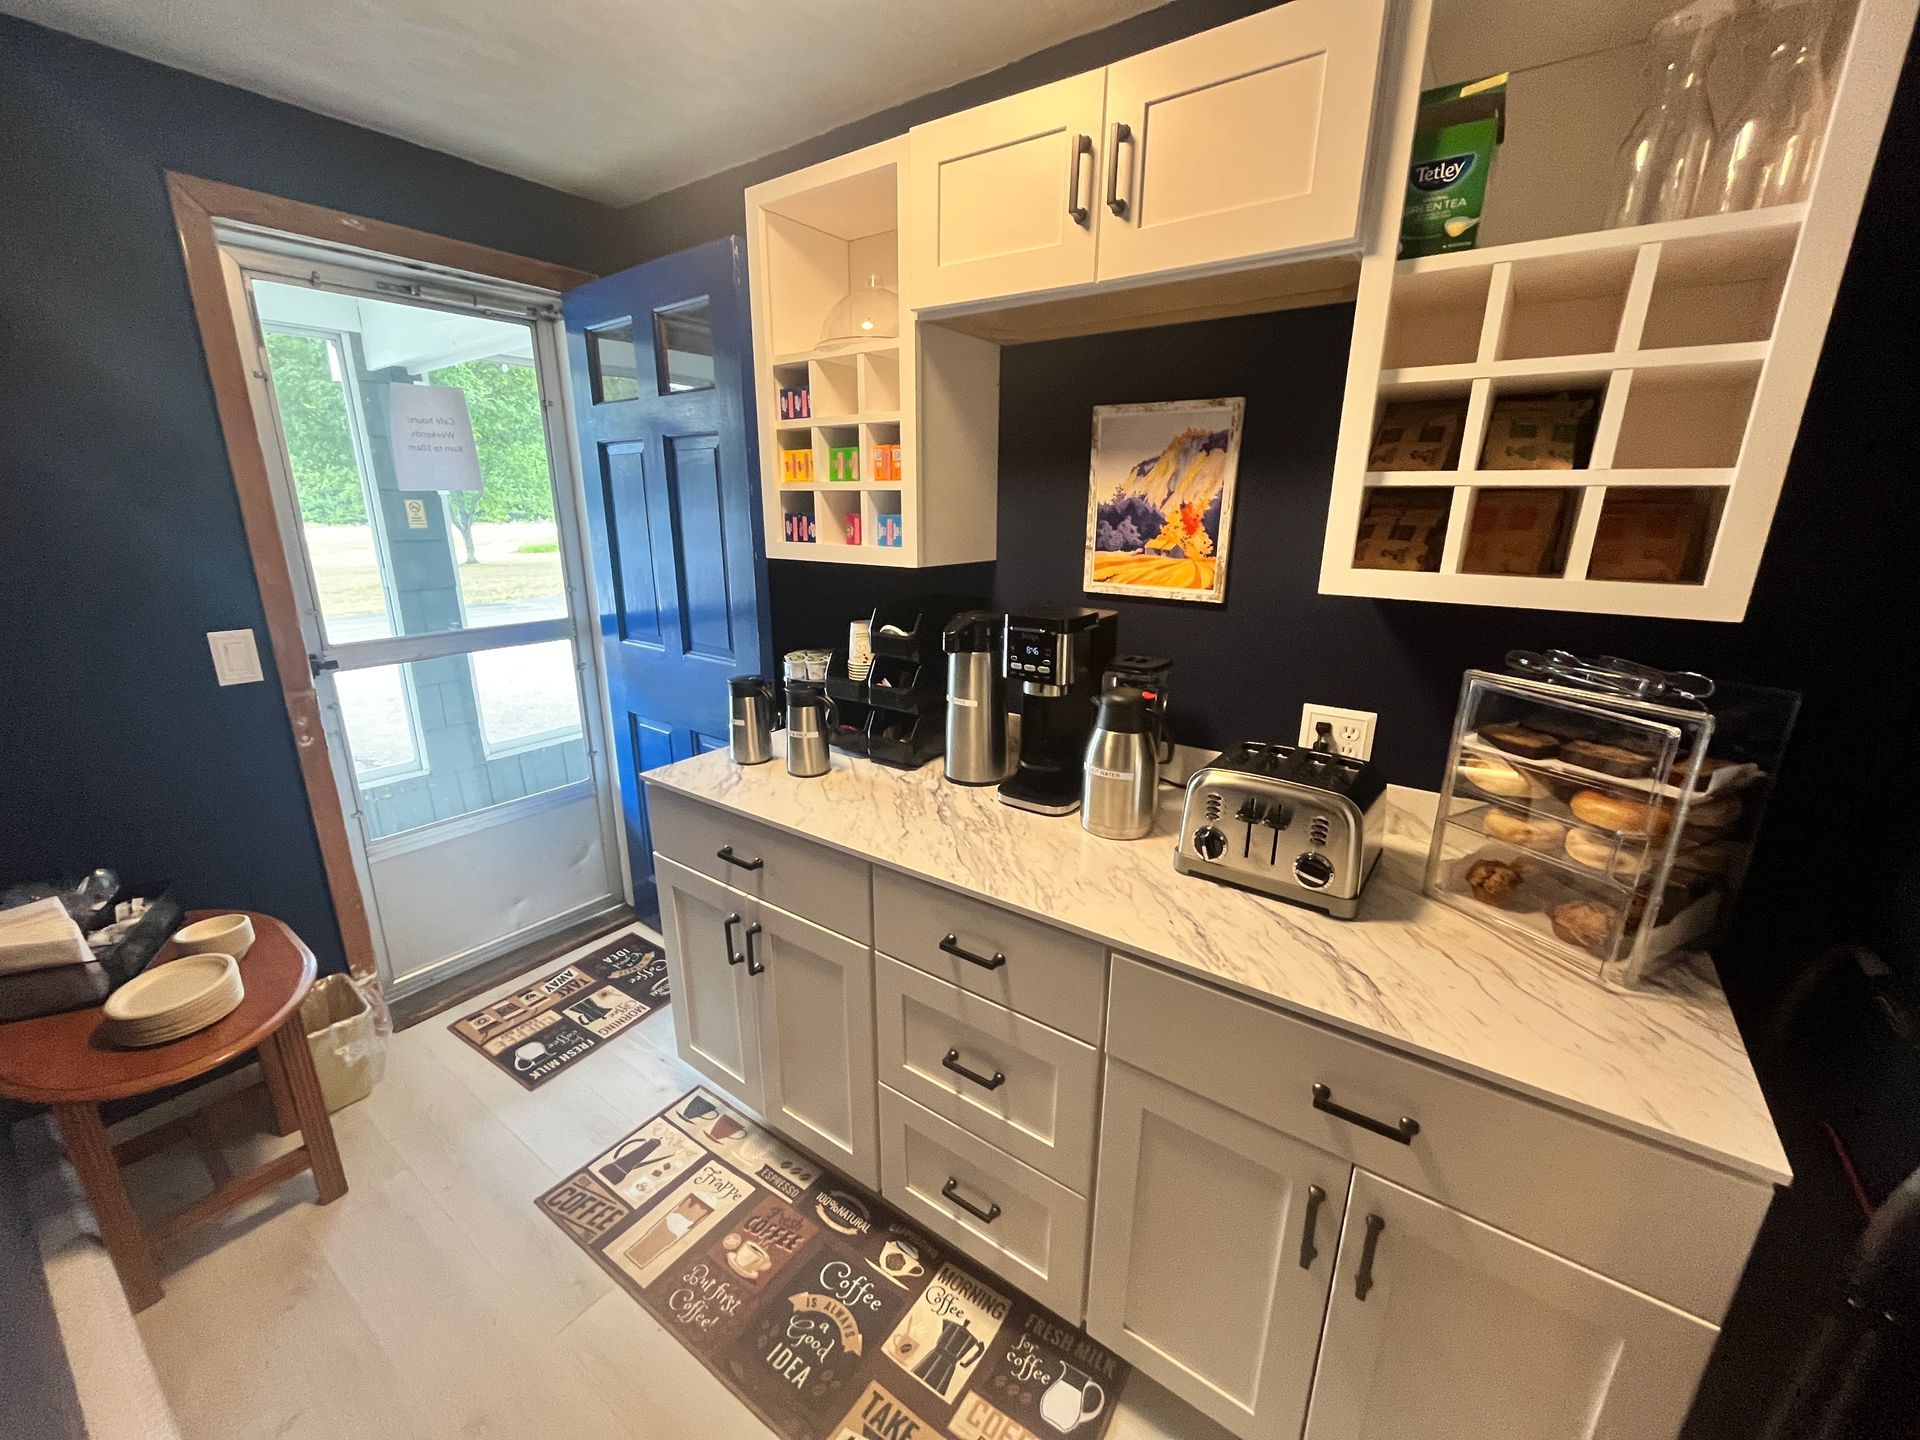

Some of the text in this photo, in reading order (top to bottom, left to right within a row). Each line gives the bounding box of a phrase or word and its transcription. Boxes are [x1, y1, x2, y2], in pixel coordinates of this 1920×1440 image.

[1415, 160, 1466, 183] Tetley
[1444, 197, 1467, 208] TEA
[1100, 770, 1121, 779] WATER
[602, 948, 631, 964] IDEA
[629, 959, 667, 984] Coffee
[544, 970, 575, 993] AWAY
[558, 978, 591, 998] TAKE
[598, 1003, 648, 1037] MORNING
[529, 1038, 595, 1080] FRESH MILK
[694, 1166, 743, 1201] Frappe
[759, 1169, 799, 1199] ESPRESSO
[547, 1186, 624, 1232] COFFEE
[742, 1214, 806, 1253] COFFEE
[683, 1264, 716, 1292] But
[820, 1261, 882, 1311] Coffee
[936, 1266, 1007, 1320] MORNING
[669, 1289, 720, 1332] Coffee!
[806, 1297, 855, 1338] IS ALWAYS
[925, 1285, 964, 1319] Coffee
[787, 1314, 835, 1363] Good
[819, 1322, 830, 1334] a
[1011, 1332, 1038, 1353] for
[1024, 1313, 1118, 1380] FRESH MILK
[766, 1342, 812, 1390] IDEA
[1006, 1351, 1051, 1385] coffee
[862, 1390, 921, 1440] TAKE
